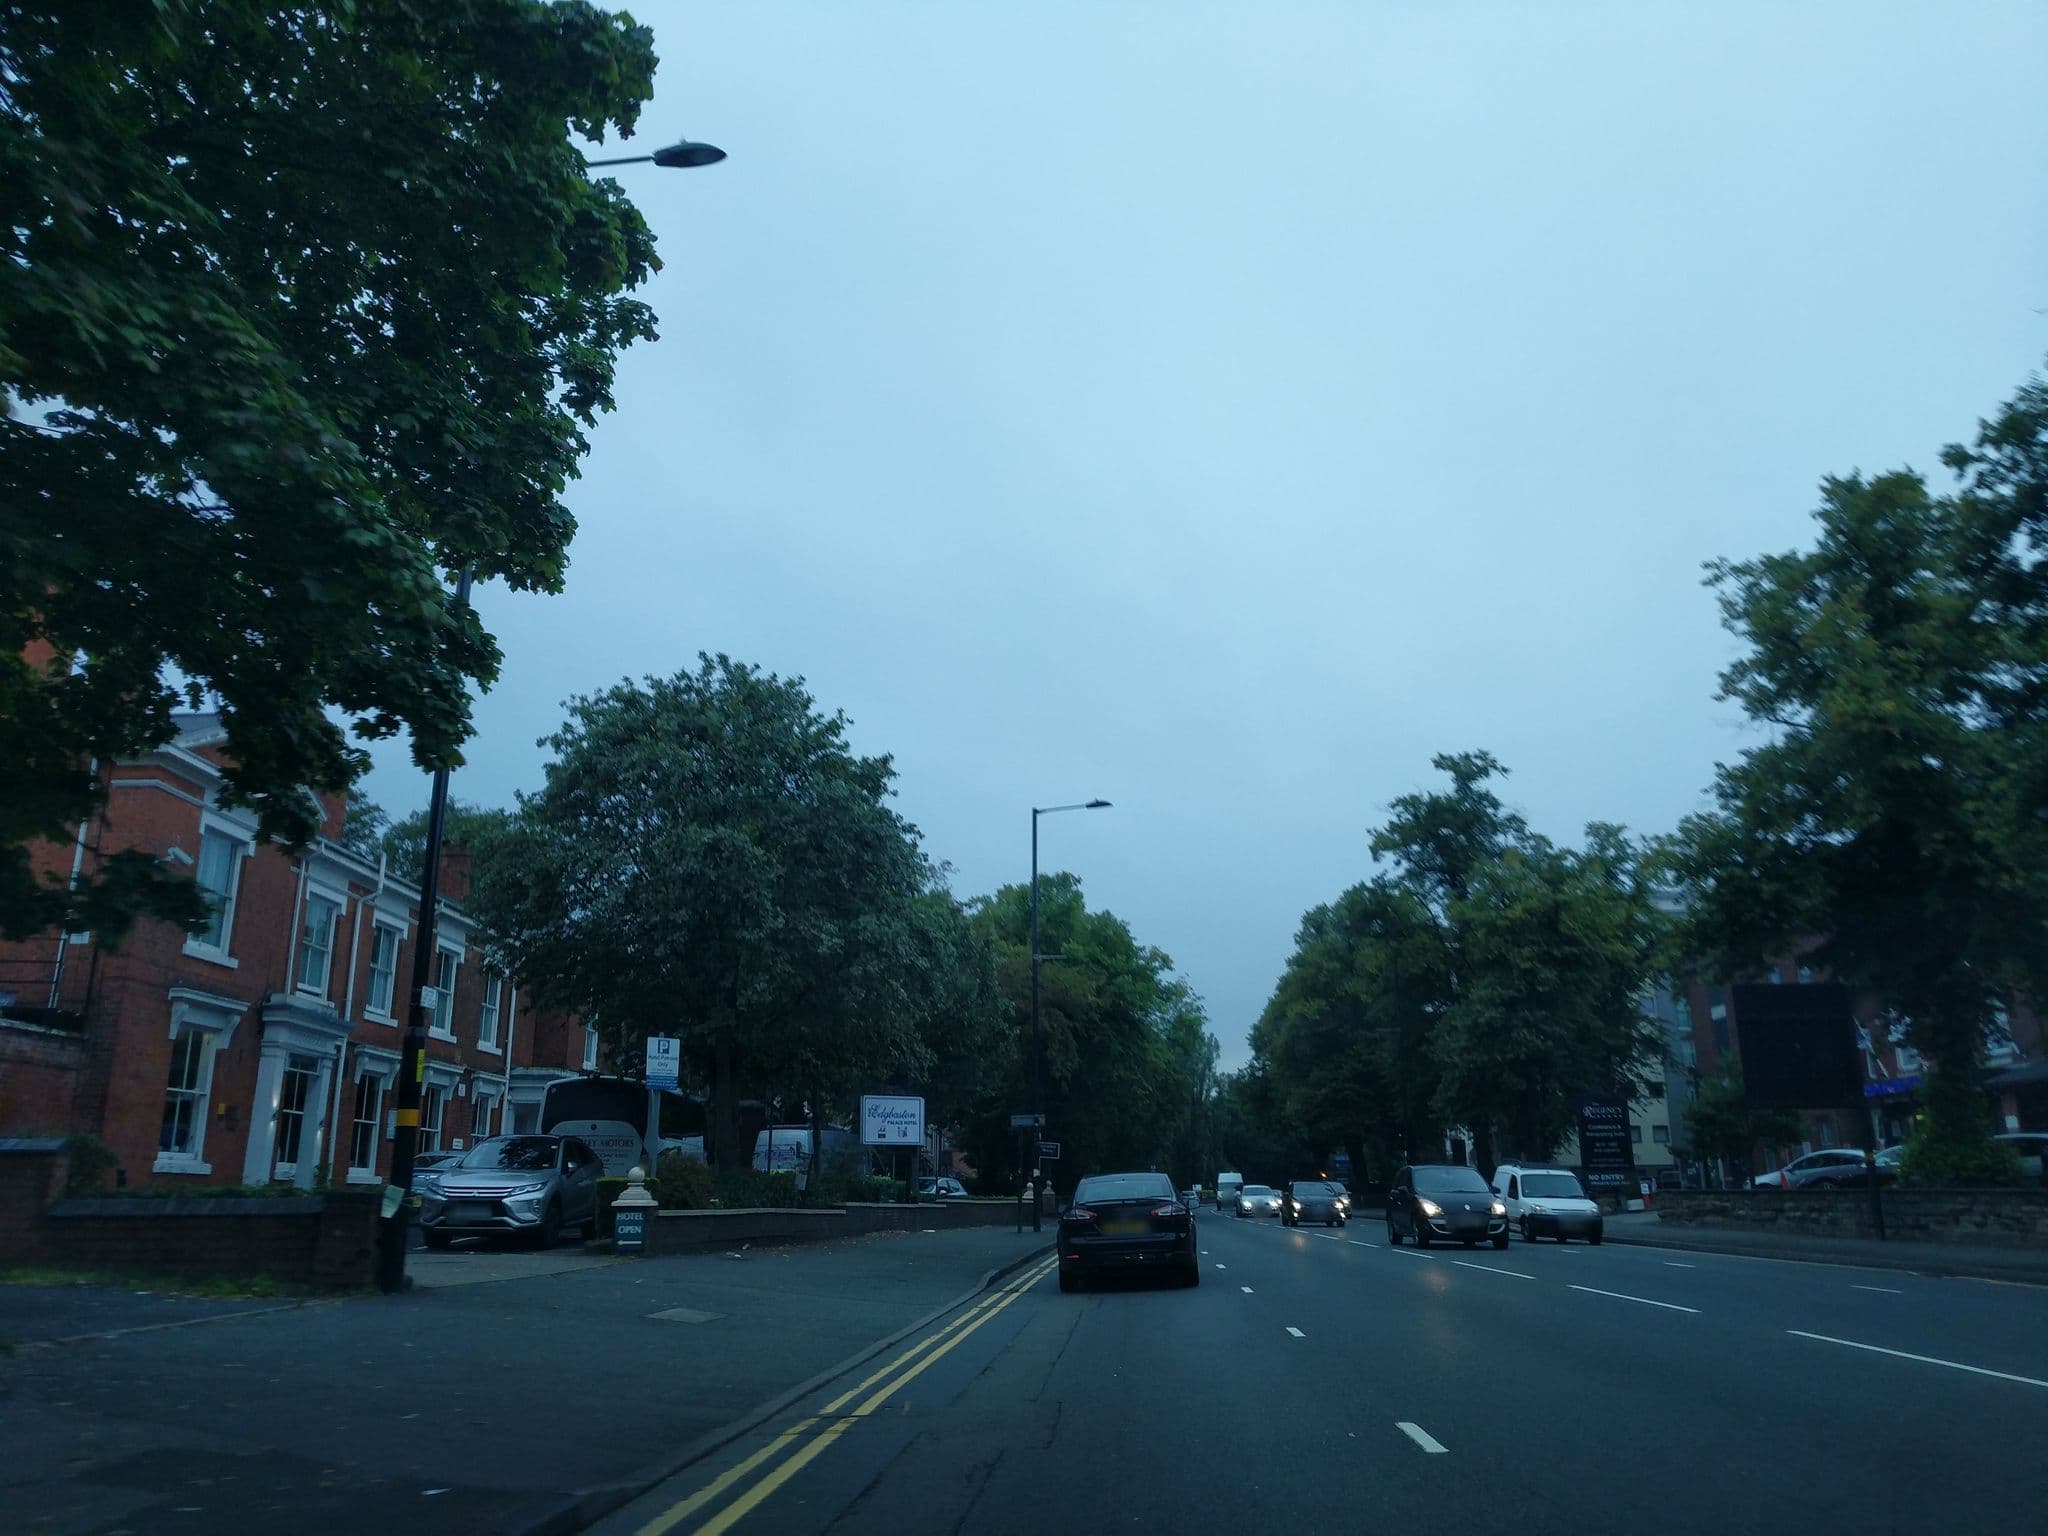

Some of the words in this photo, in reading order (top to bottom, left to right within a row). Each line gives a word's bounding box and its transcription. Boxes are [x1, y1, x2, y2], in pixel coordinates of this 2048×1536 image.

[660, 1041, 669, 1053] P
[871, 1104, 916, 1123] Edgbaston
[1601, 1174, 1624, 1182] ENTRY
[616, 1211, 644, 1220] HOTEL
[618, 1225, 642, 1234] OPEN
